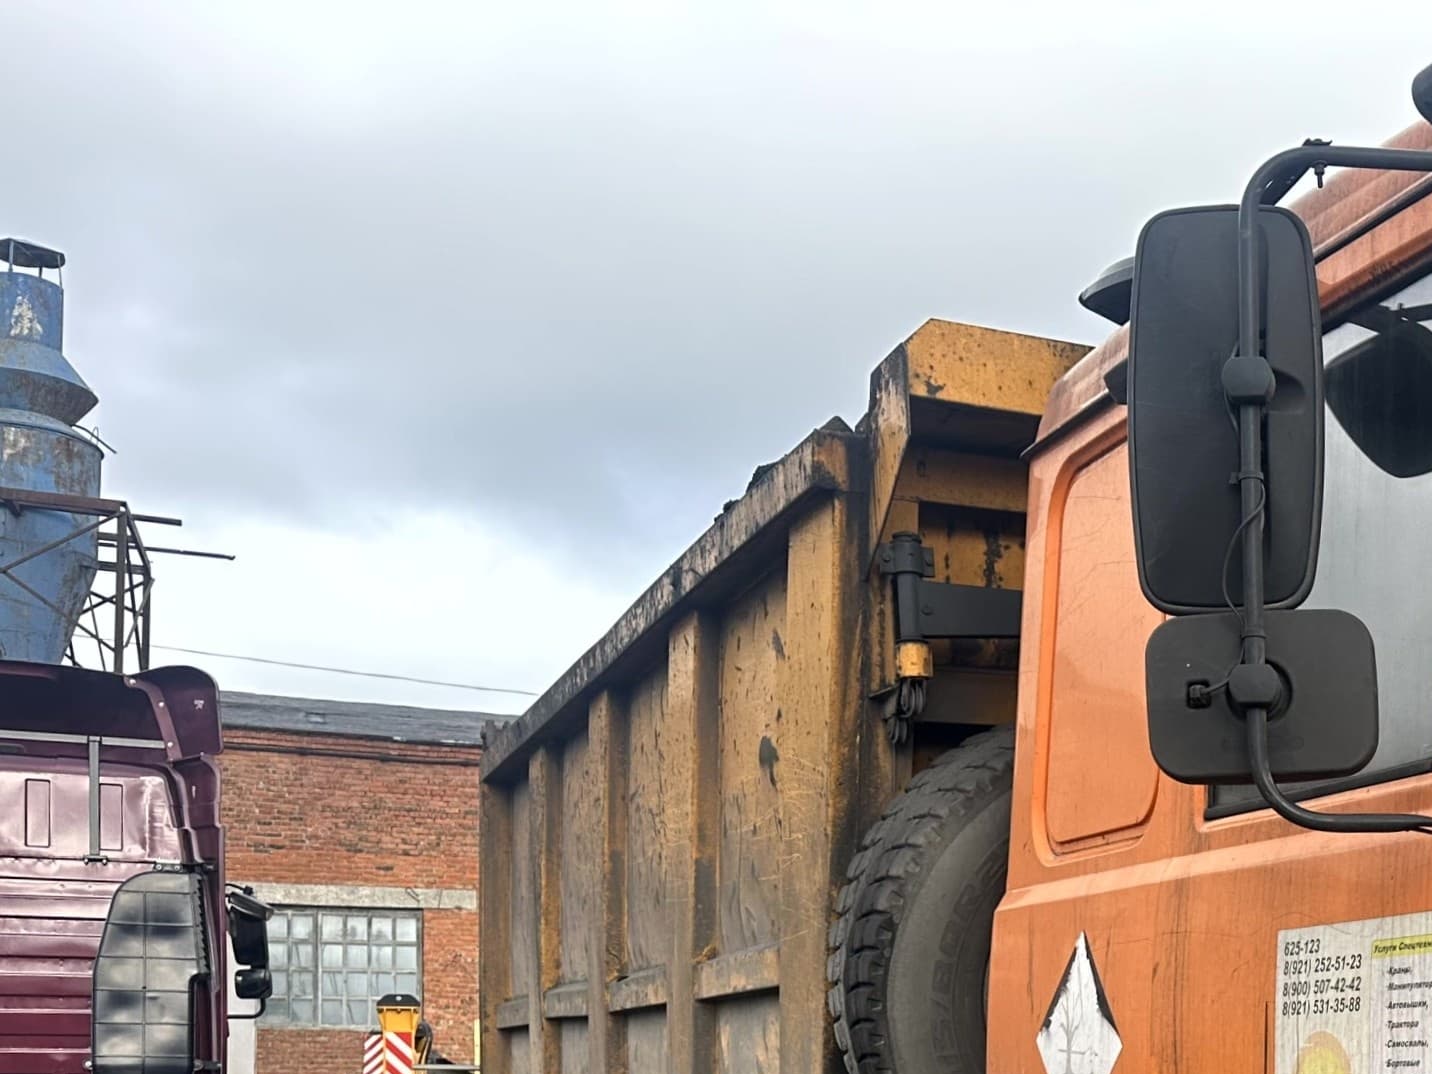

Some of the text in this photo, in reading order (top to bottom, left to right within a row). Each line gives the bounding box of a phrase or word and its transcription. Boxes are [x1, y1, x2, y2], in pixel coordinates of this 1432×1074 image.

[1284, 938, 1321, 957] 625-123
[1283, 954, 1362, 978] 8(921) 252-51-23
[1282, 976, 1362, 1000] 8(900) 507-42-42
[1282, 997, 1361, 1019] 8(921) 531-35-88
